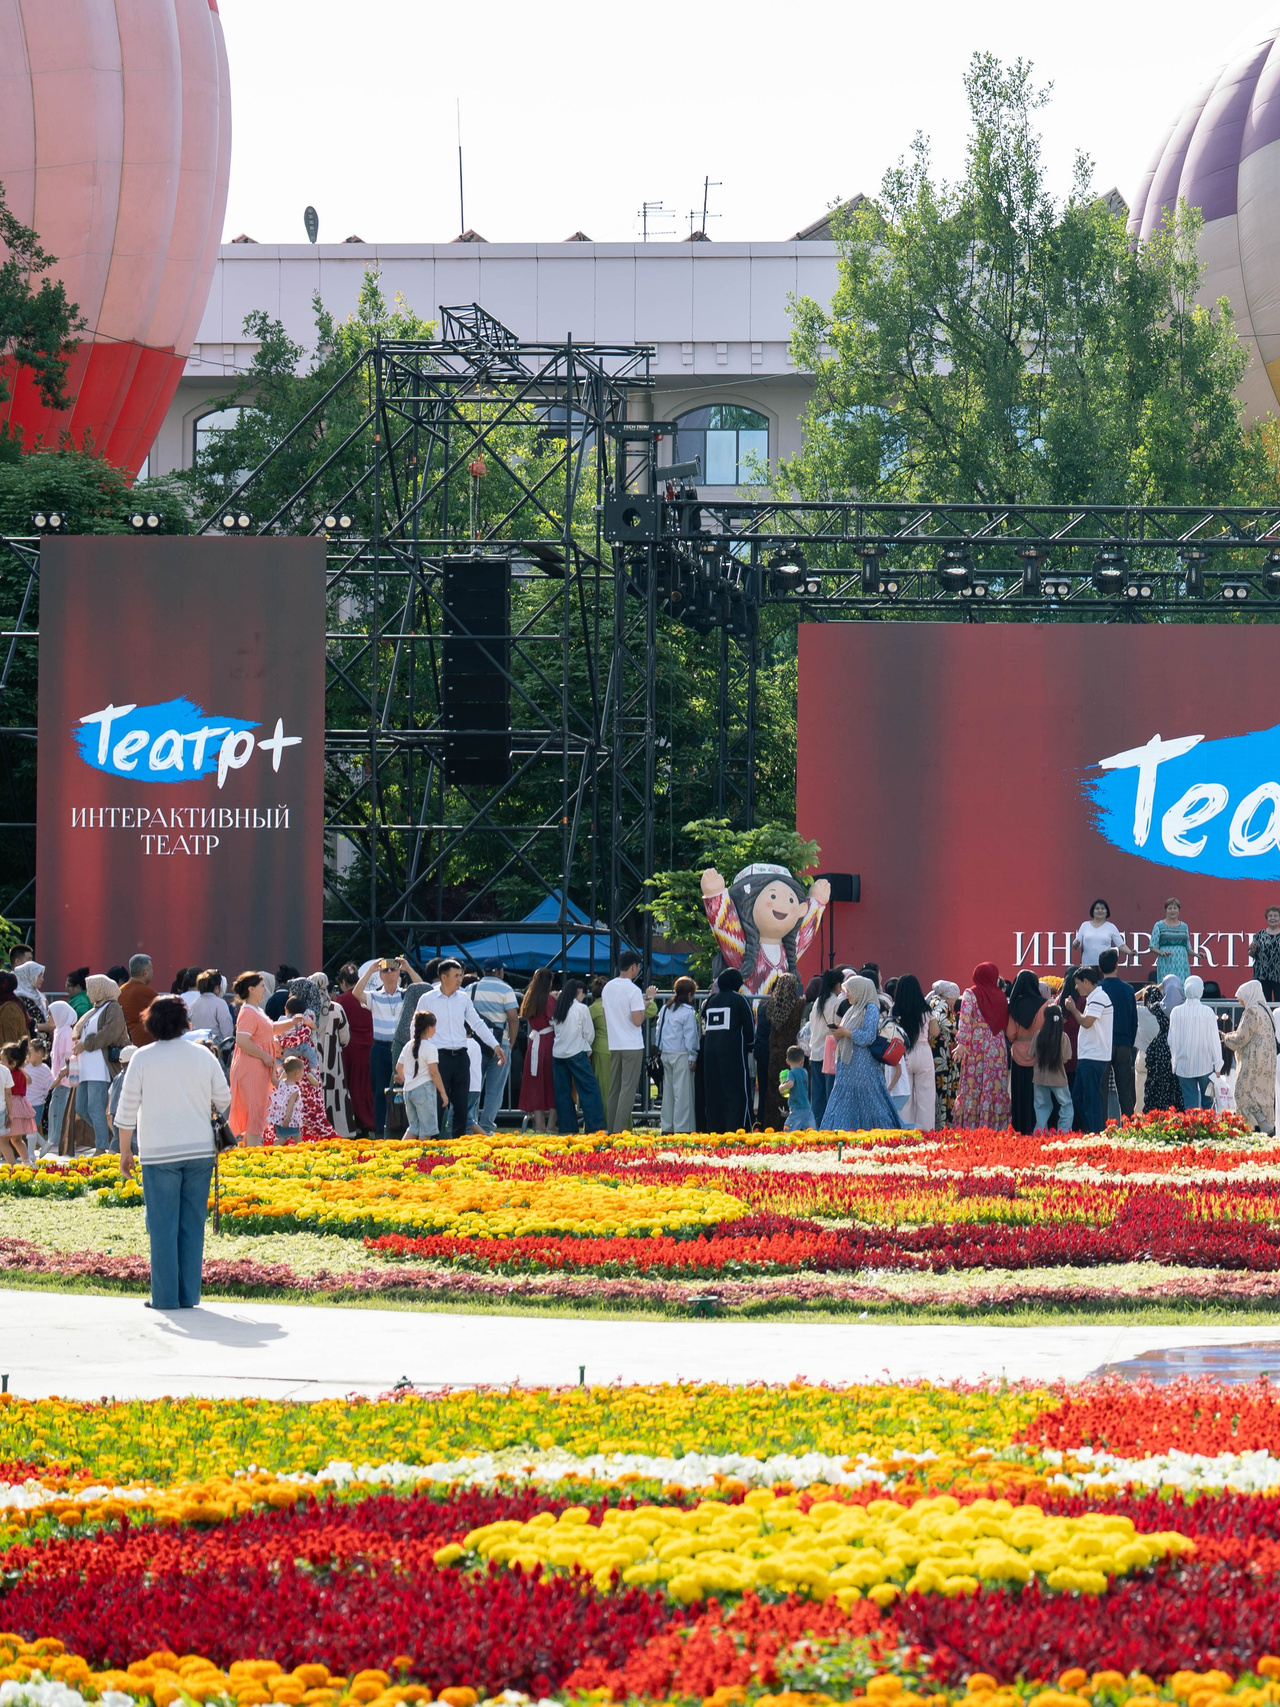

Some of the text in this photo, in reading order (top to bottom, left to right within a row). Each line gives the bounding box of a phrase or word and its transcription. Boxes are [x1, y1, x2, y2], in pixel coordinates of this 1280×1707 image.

[78, 703, 302, 789] Театр+
[71, 804, 290, 828] ИНТЕРАКТИВНЫЙ
[141, 834, 220, 856] ТЕАТР
